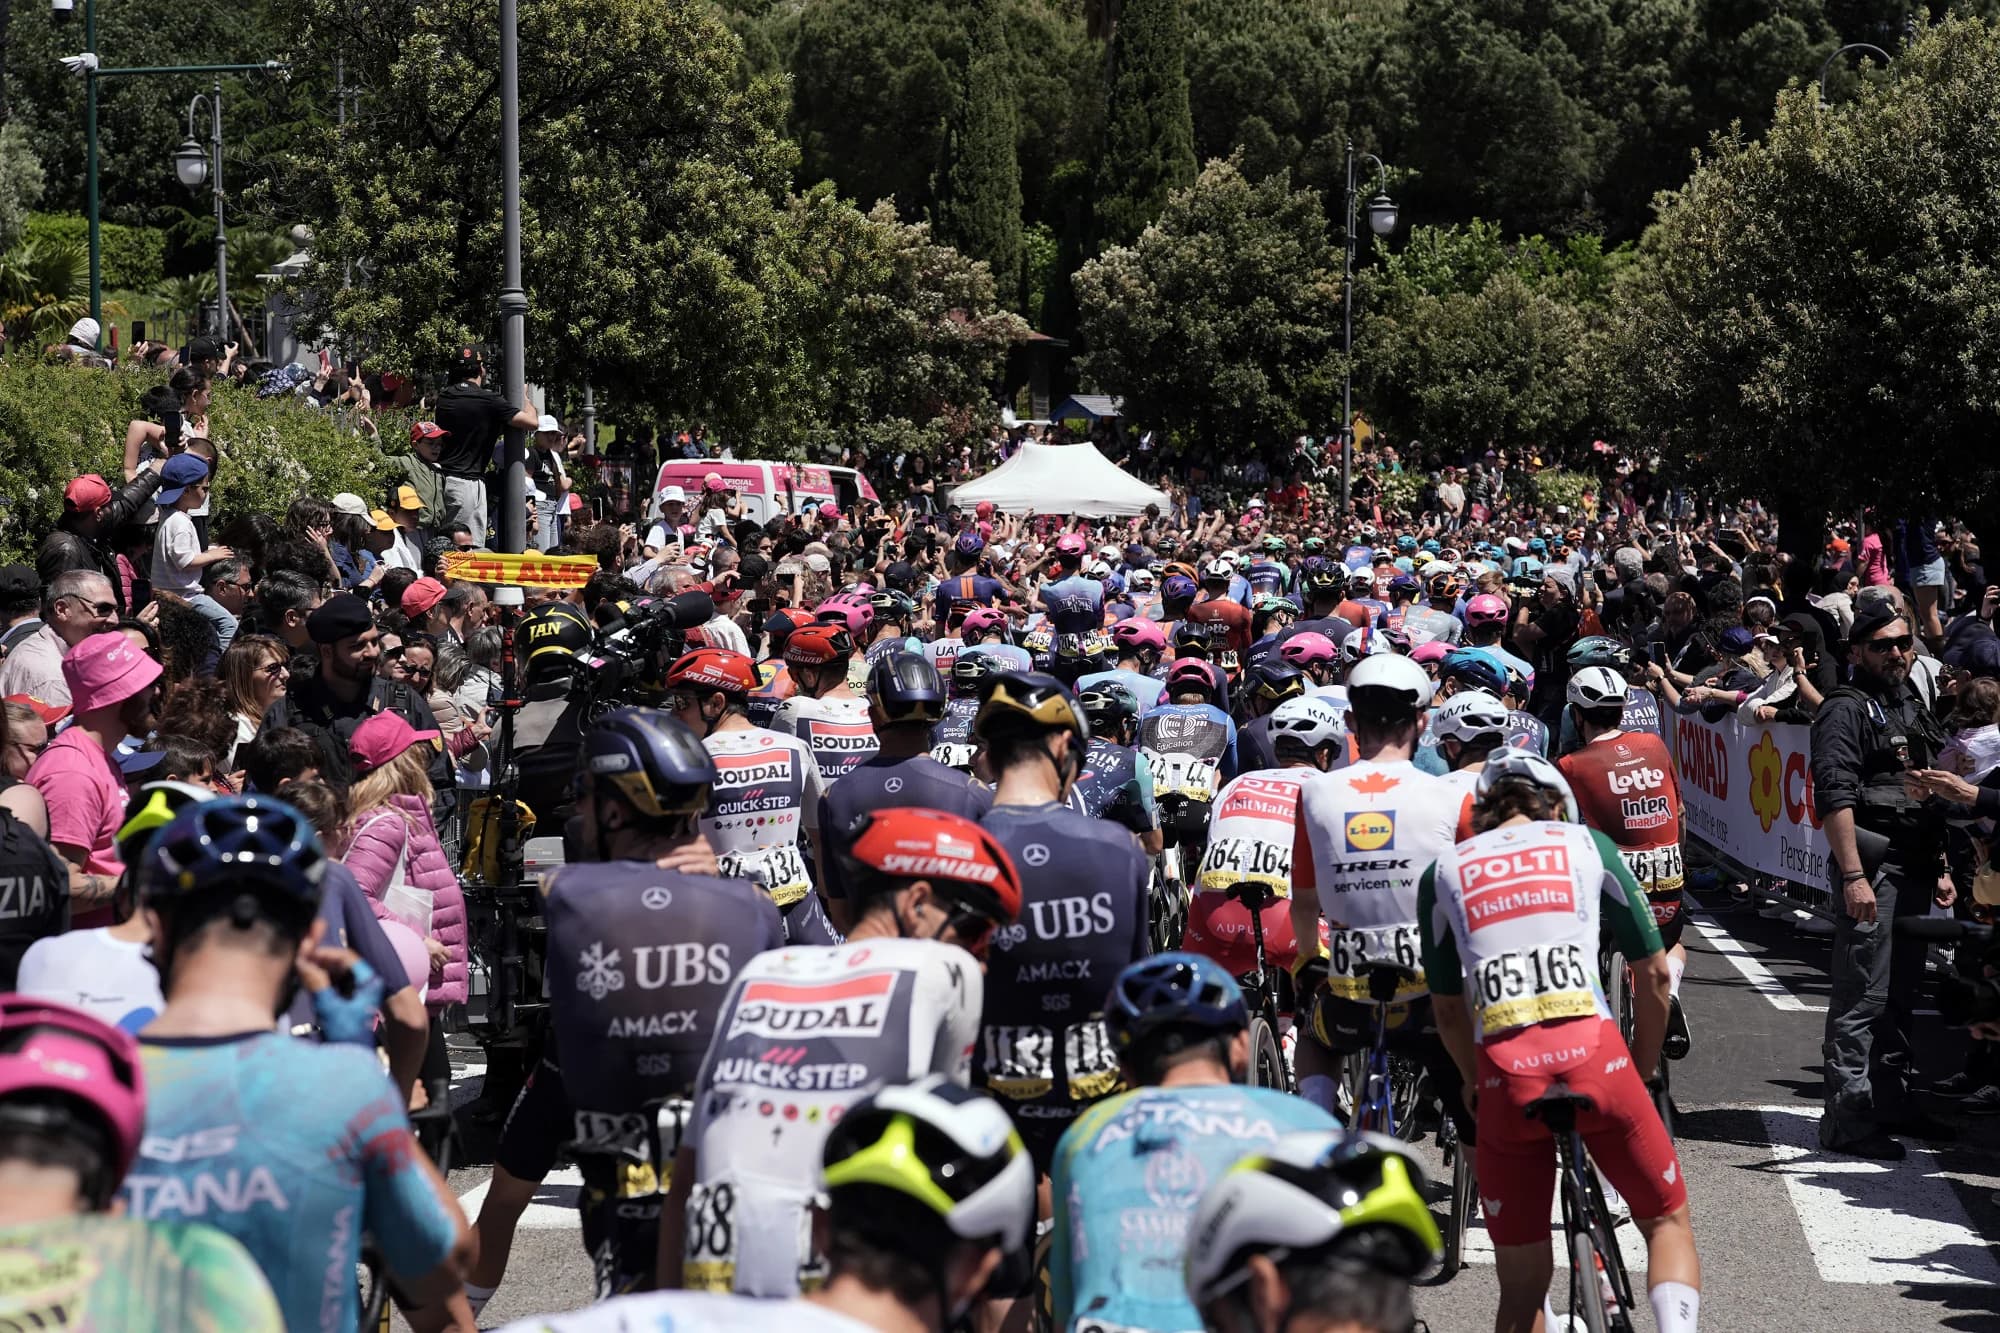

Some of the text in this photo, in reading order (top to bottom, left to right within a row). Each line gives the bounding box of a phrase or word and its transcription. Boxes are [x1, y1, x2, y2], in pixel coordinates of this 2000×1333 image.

[470, 561, 504, 582] TI
[530, 622, 561, 643] JAN
[867, 648, 896, 666] RAIN
[683, 669, 743, 691] SPECIALIZED
[1307, 708, 1340, 730] KASK
[1438, 703, 1473, 723] KASK
[1623, 705, 1657, 720] RAIN
[813, 735, 878, 750] SOUDA
[1156, 741, 1194, 751] Education
[1086, 751, 1121, 766] AIN
[1679, 718, 1728, 801] CONAD
[1186, 761, 1207, 788] 44
[1608, 767, 1664, 794] Lotto
[878, 854, 1000, 882] SPECIALIZED
[1204, 837, 1290, 878] 164 164
[1332, 858, 1413, 875] TREK
[1661, 847, 1681, 877] 76
[1781, 835, 1823, 878] Persone
[1464, 849, 1565, 889] POLTI
[1334, 876, 1415, 894] servicenow
[1028, 892, 1115, 940] UBS
[1470, 887, 1569, 921] VisitMalta
[1334, 931, 1367, 975] 63
[632, 942, 731, 989] UBS
[1016, 959, 1092, 983] AMACX
[1475, 944, 1587, 1009] 165 165
[1042, 995, 1071, 1011] SGS
[608, 1009, 698, 1037] AMACX
[637, 1053, 671, 1075] SGS
[1513, 1047, 1587, 1070] AURUM
[123, 1165, 290, 1220] TANA
